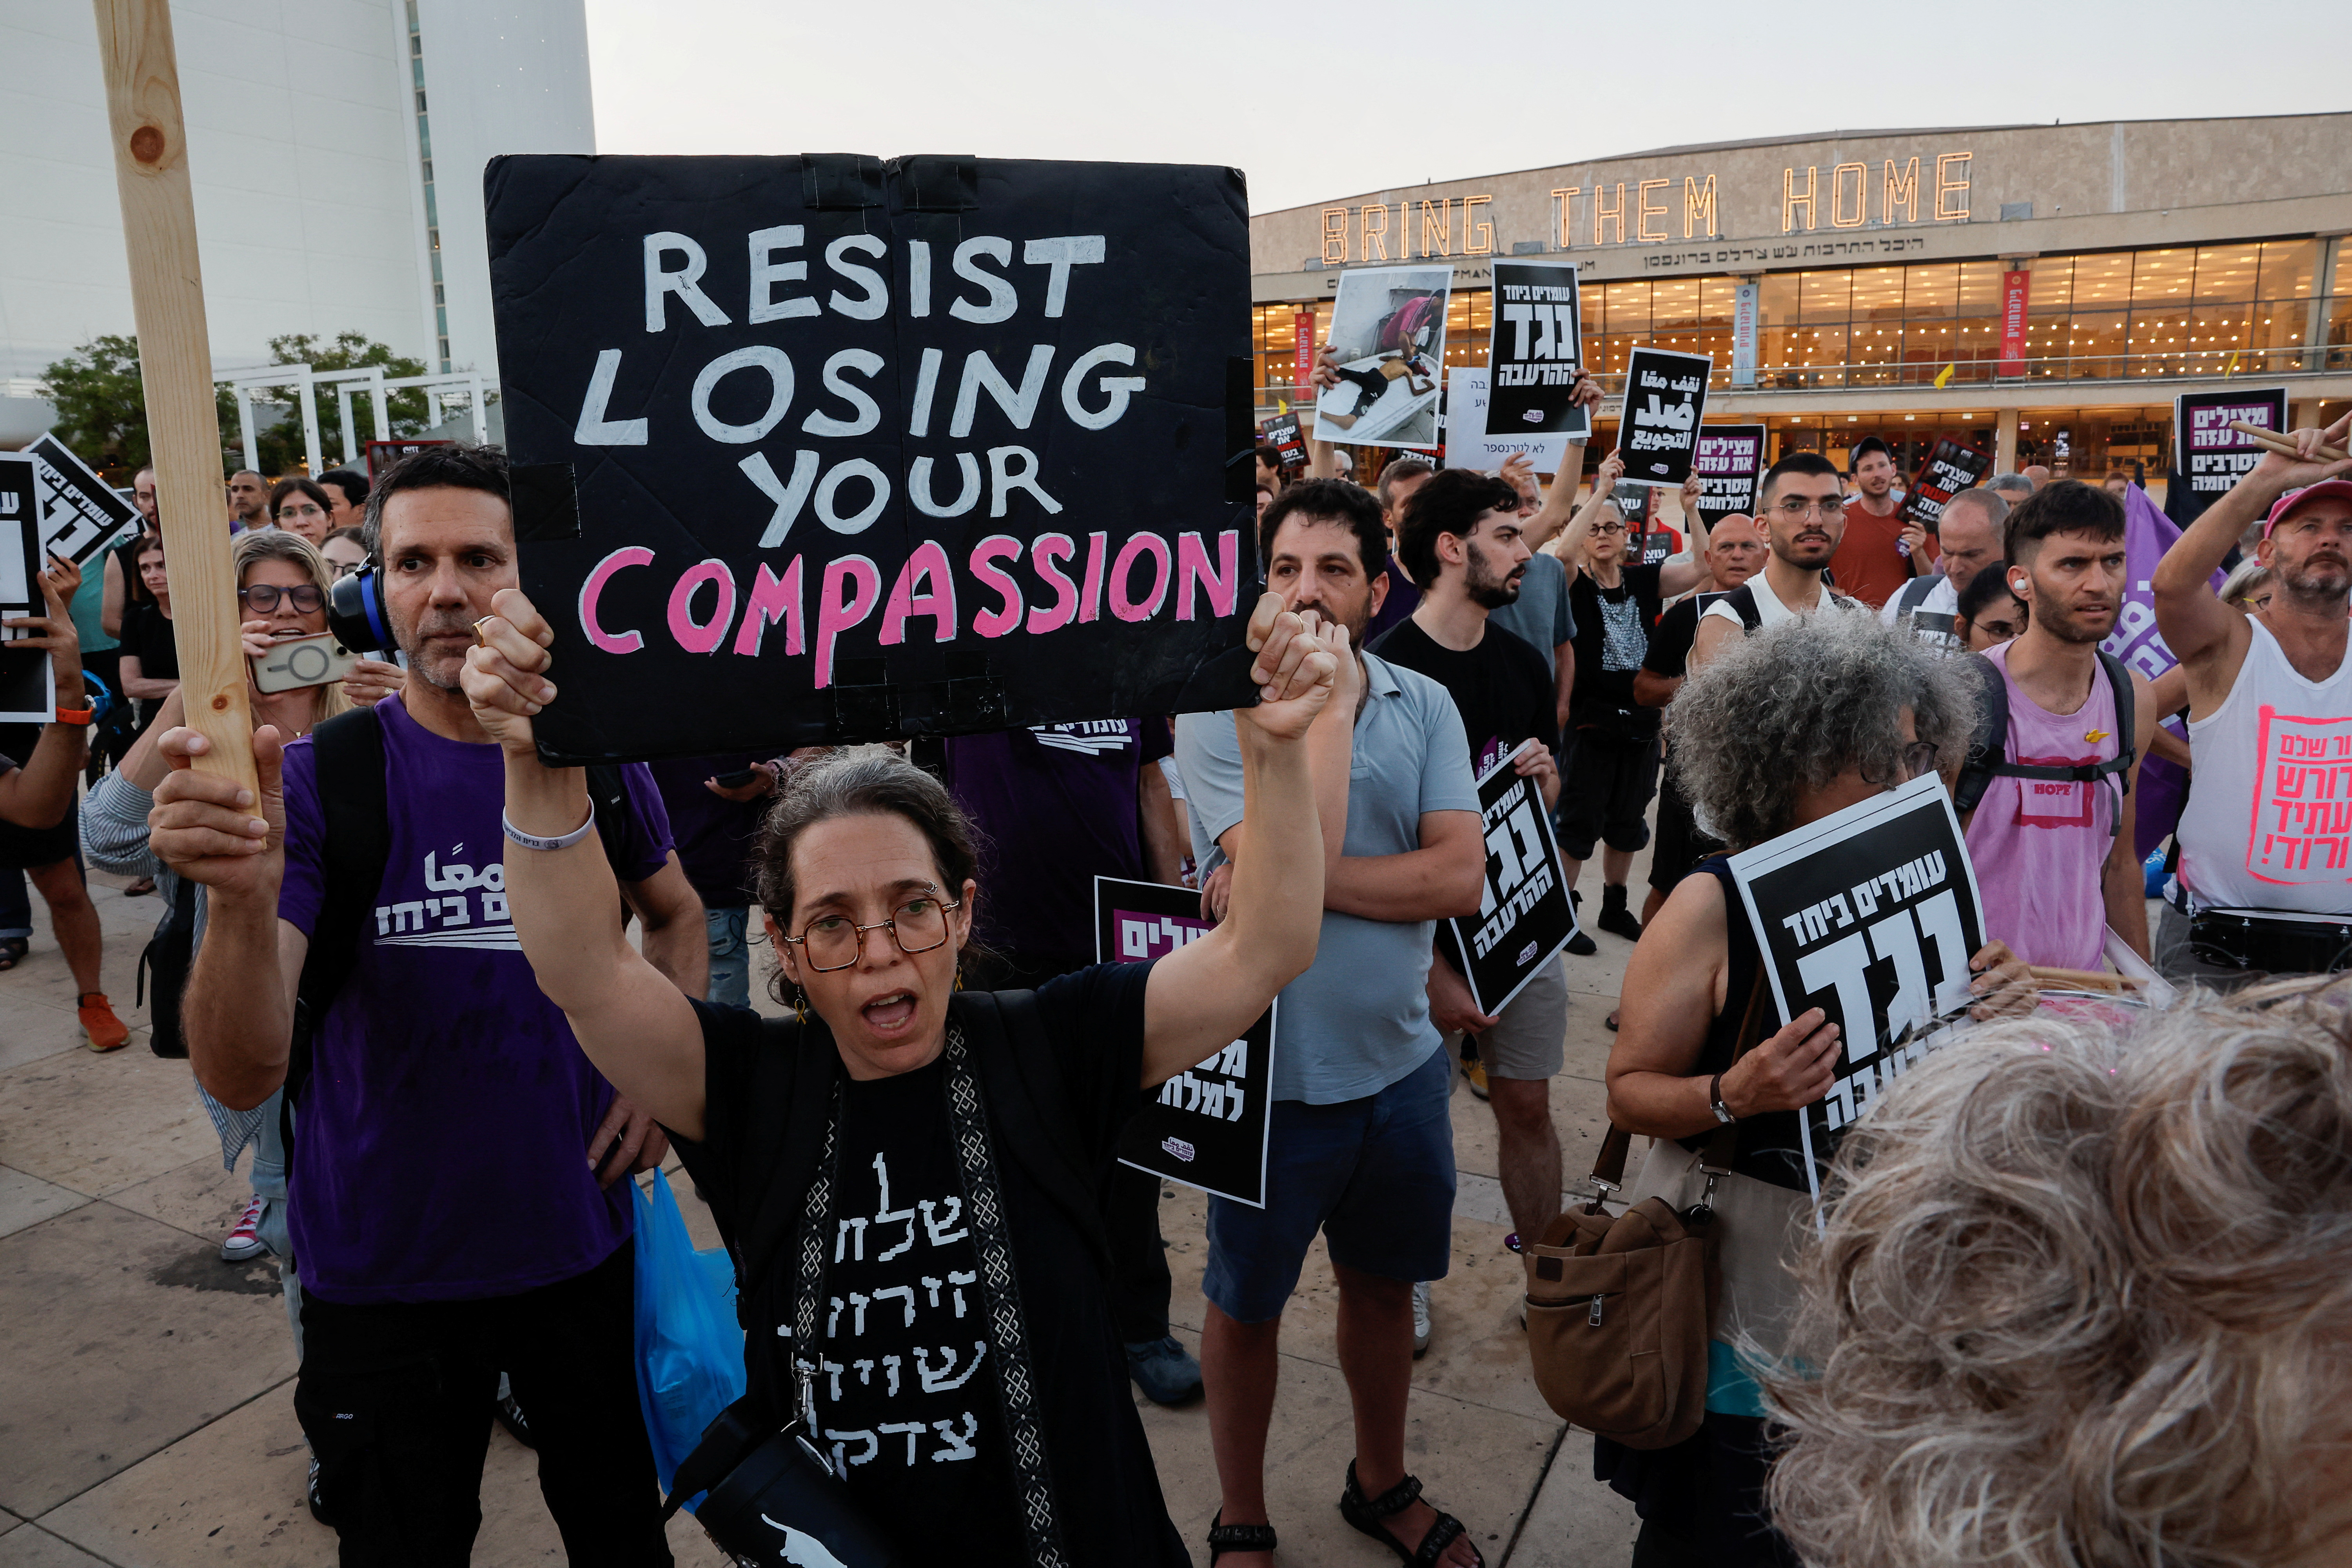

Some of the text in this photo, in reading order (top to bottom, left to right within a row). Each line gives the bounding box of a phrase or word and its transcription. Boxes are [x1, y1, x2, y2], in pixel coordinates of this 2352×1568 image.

[1322, 151, 1972, 265] BRING THEM HOME
[1804, 240, 1873, 256] התרבות
[1880, 238, 1923, 252] היכל
[644, 225, 1105, 332] RESIST
[1503, 285, 1570, 301] עומדים ביחד
[1504, 304, 1575, 359] נגד
[1499, 363, 1575, 386] ההרעבה
[574, 342, 1146, 445] LOSING
[1635, 393, 1695, 431] ضد
[2194, 407, 2268, 427] מצילים
[1277, 435, 1290, 445] את
[1484, 442, 1544, 453] לא לטרנספר
[1631, 430, 1691, 450] التجويع
[1699, 437, 1754, 455] מצילים
[2194, 430, 2233, 446] עזה
[1699, 457, 1753, 471] את עזה
[1933, 460, 1975, 484] עוצרים
[739, 445, 1062, 548] YOUR
[1937, 477, 1959, 493] את
[63, 483, 114, 527] עומדים
[1918, 497, 1945, 514] עזה
[40, 479, 102, 565] נג
[578, 530, 1238, 689] COMPASSION
[2281, 734, 2328, 757] שלם
[2034, 783, 2070, 796] HOPE
[2272, 799, 2352, 835] עתיד
[1782, 849, 1947, 946] עומדים ביחד
[1473, 863, 1553, 960] ההרעבה
[1796, 888, 1974, 1064] נגד
[1176, 1147, 1192, 1156] עומדים
